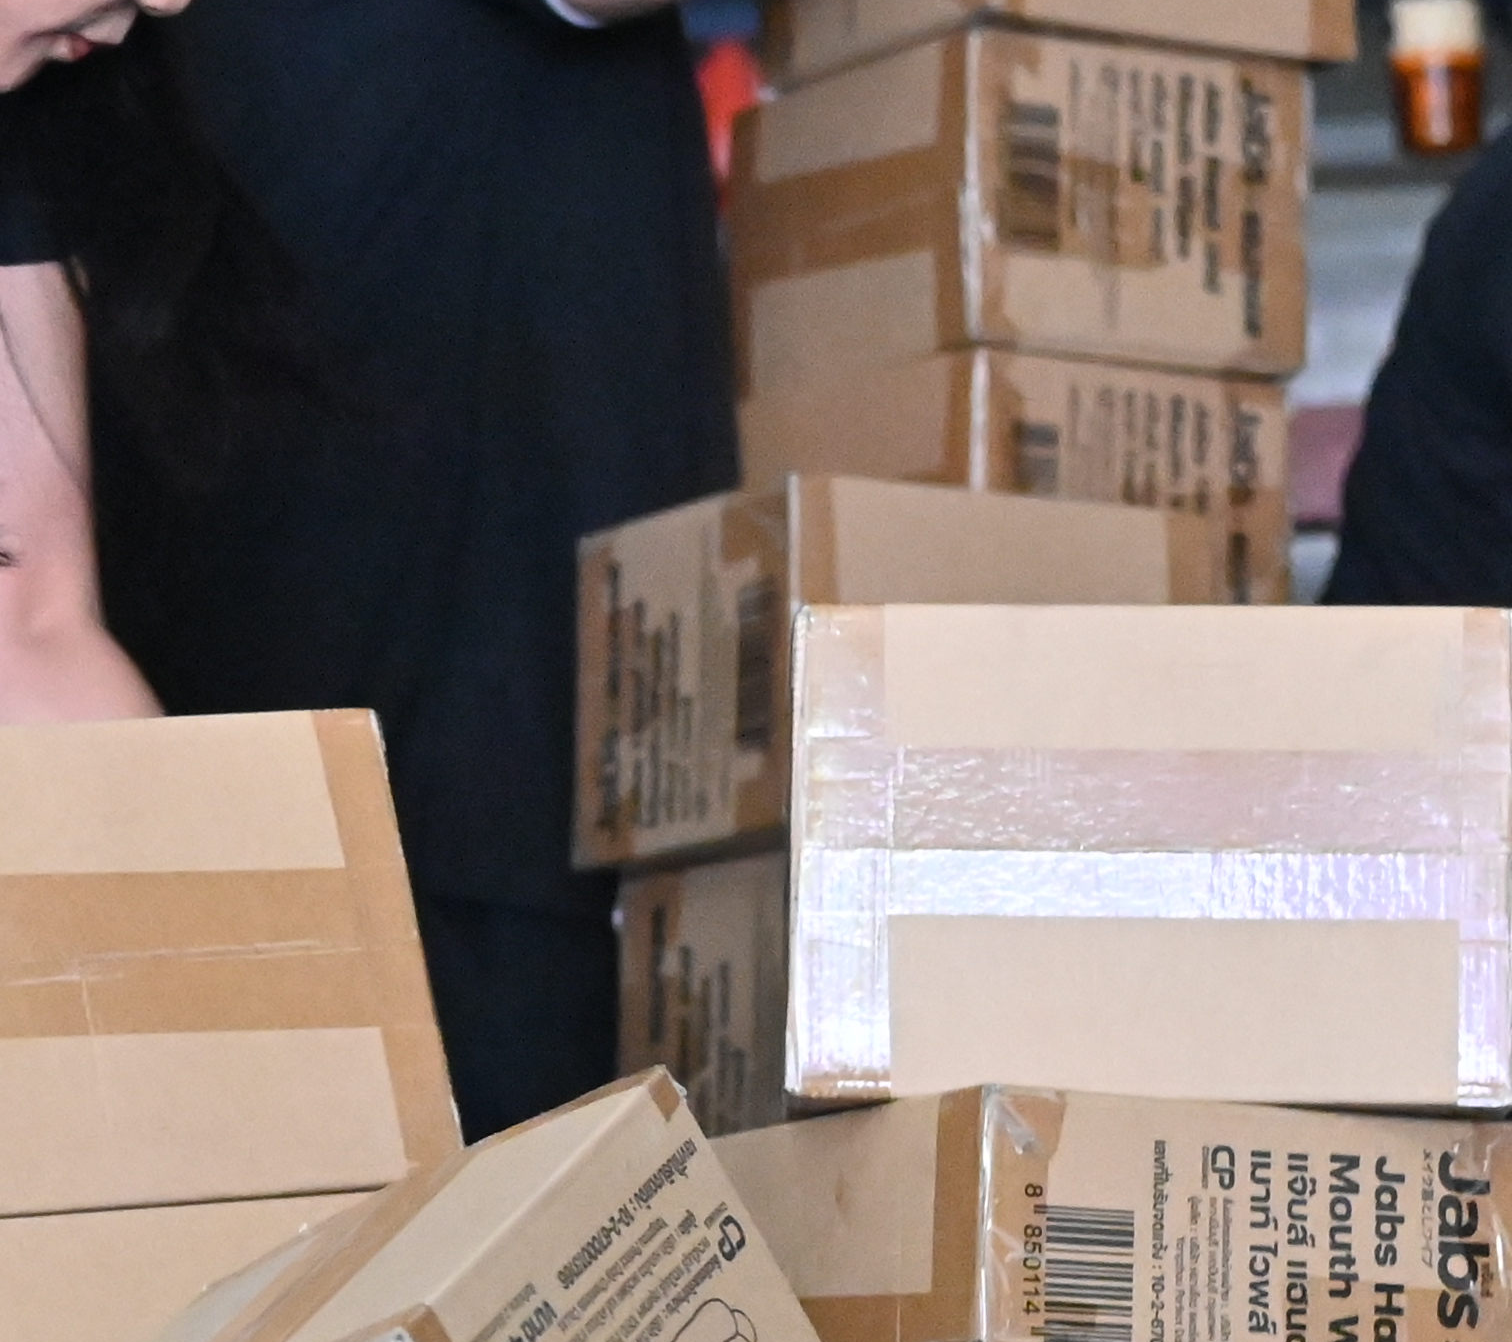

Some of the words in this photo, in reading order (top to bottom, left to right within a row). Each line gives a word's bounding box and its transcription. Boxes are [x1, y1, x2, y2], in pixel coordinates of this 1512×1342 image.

[1024, 1183, 1043, 1198] 8
[1211, 1145, 1235, 1190] CP
[1375, 1156, 1405, 1266] Jabs
[718, 1214, 746, 1262] CP
[1023, 1224, 1047, 1315] 850114
[1328, 1154, 1360, 1299] Mouth
[1437, 1151, 1493, 1329] Jabs
